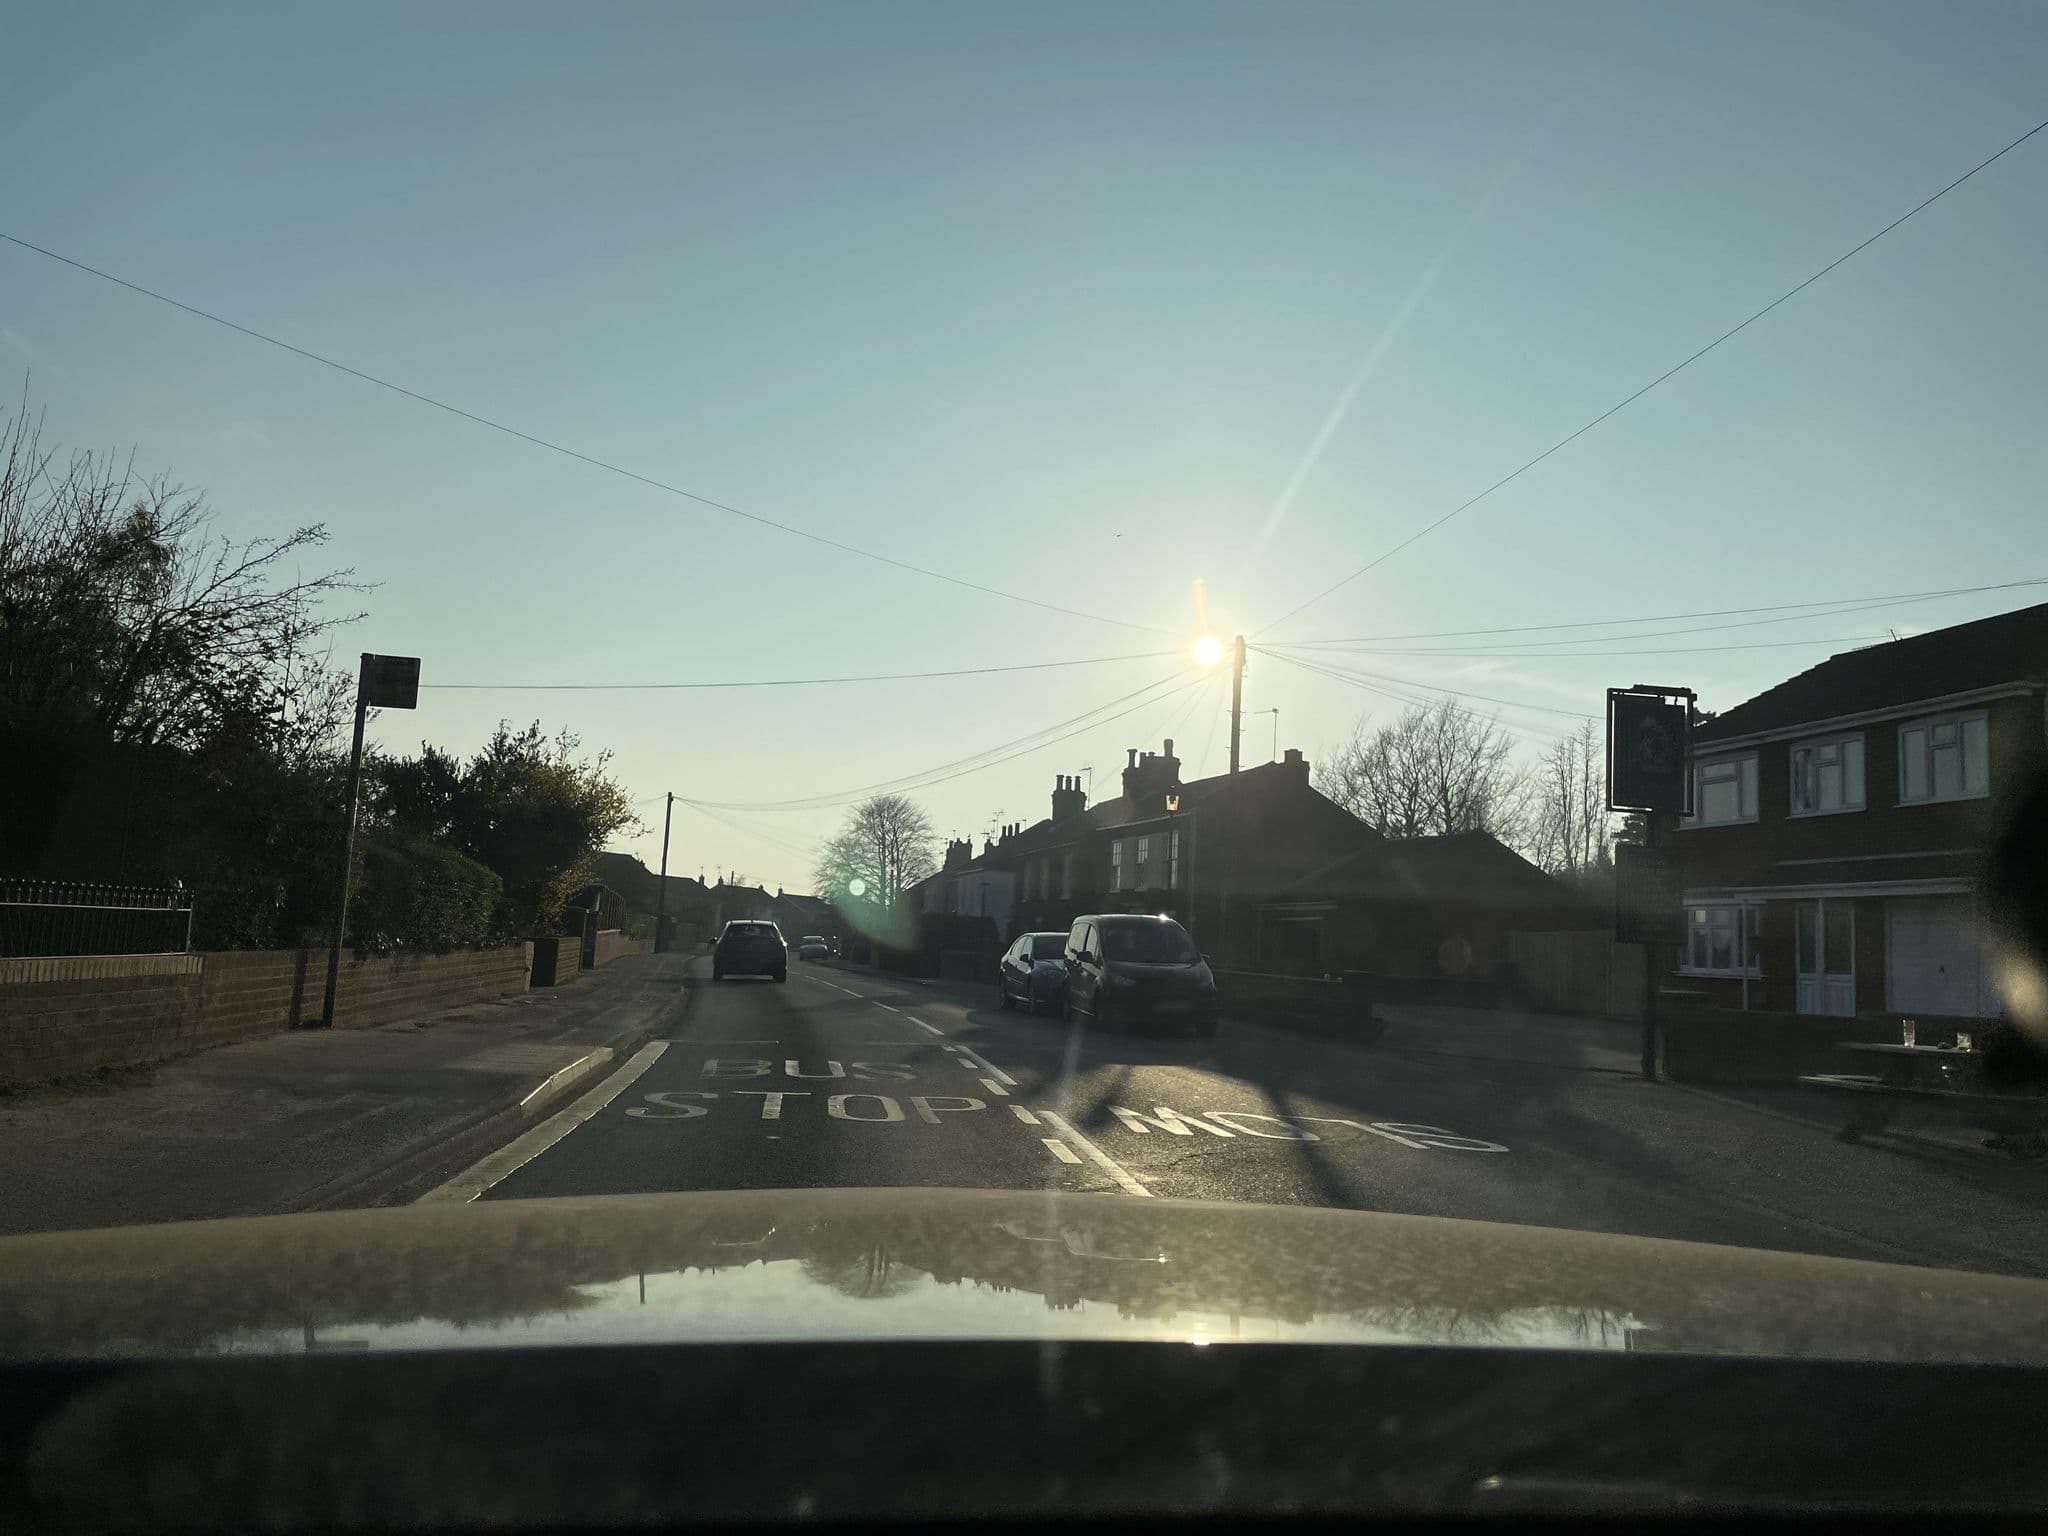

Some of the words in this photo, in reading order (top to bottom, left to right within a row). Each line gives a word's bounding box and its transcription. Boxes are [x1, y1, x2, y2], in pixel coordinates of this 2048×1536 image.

[702, 1059, 918, 1080] BUS
[625, 1091, 987, 1124] STOP
[1106, 1105, 1510, 1153] SLOW
